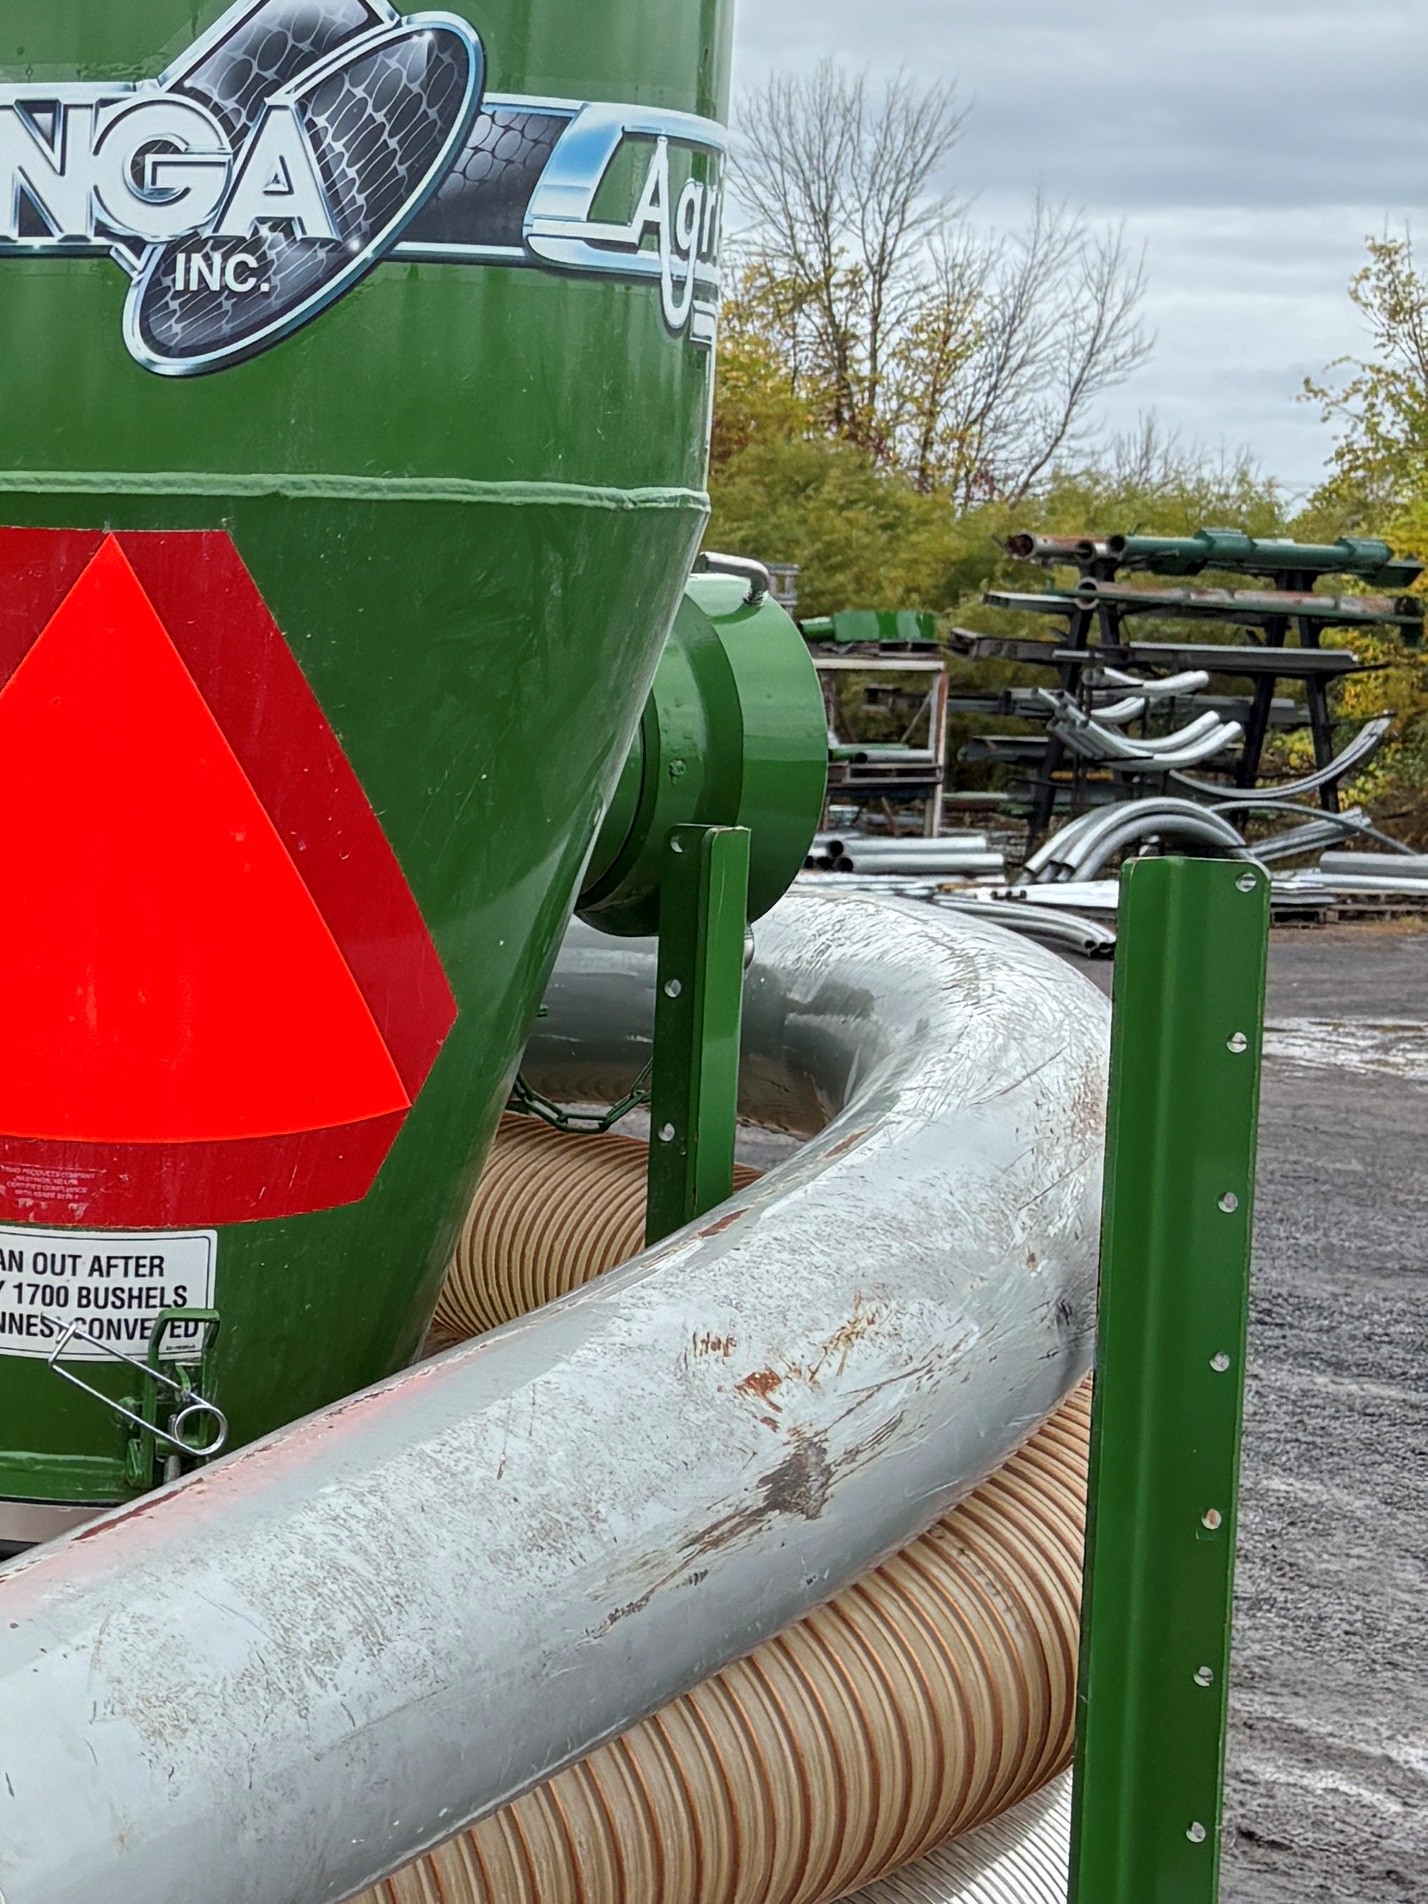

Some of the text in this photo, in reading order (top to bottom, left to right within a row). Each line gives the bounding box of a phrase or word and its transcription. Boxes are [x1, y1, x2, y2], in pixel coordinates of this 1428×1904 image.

[173, 251, 273, 295] INC.
[32, 1251, 83, 1277] OUT
[88, 1255, 165, 1279] AFTER
[13, 1282, 70, 1308] 1700
[77, 1284, 188, 1310] BUSHELS
[73, 1316, 199, 1339] CONVEED
